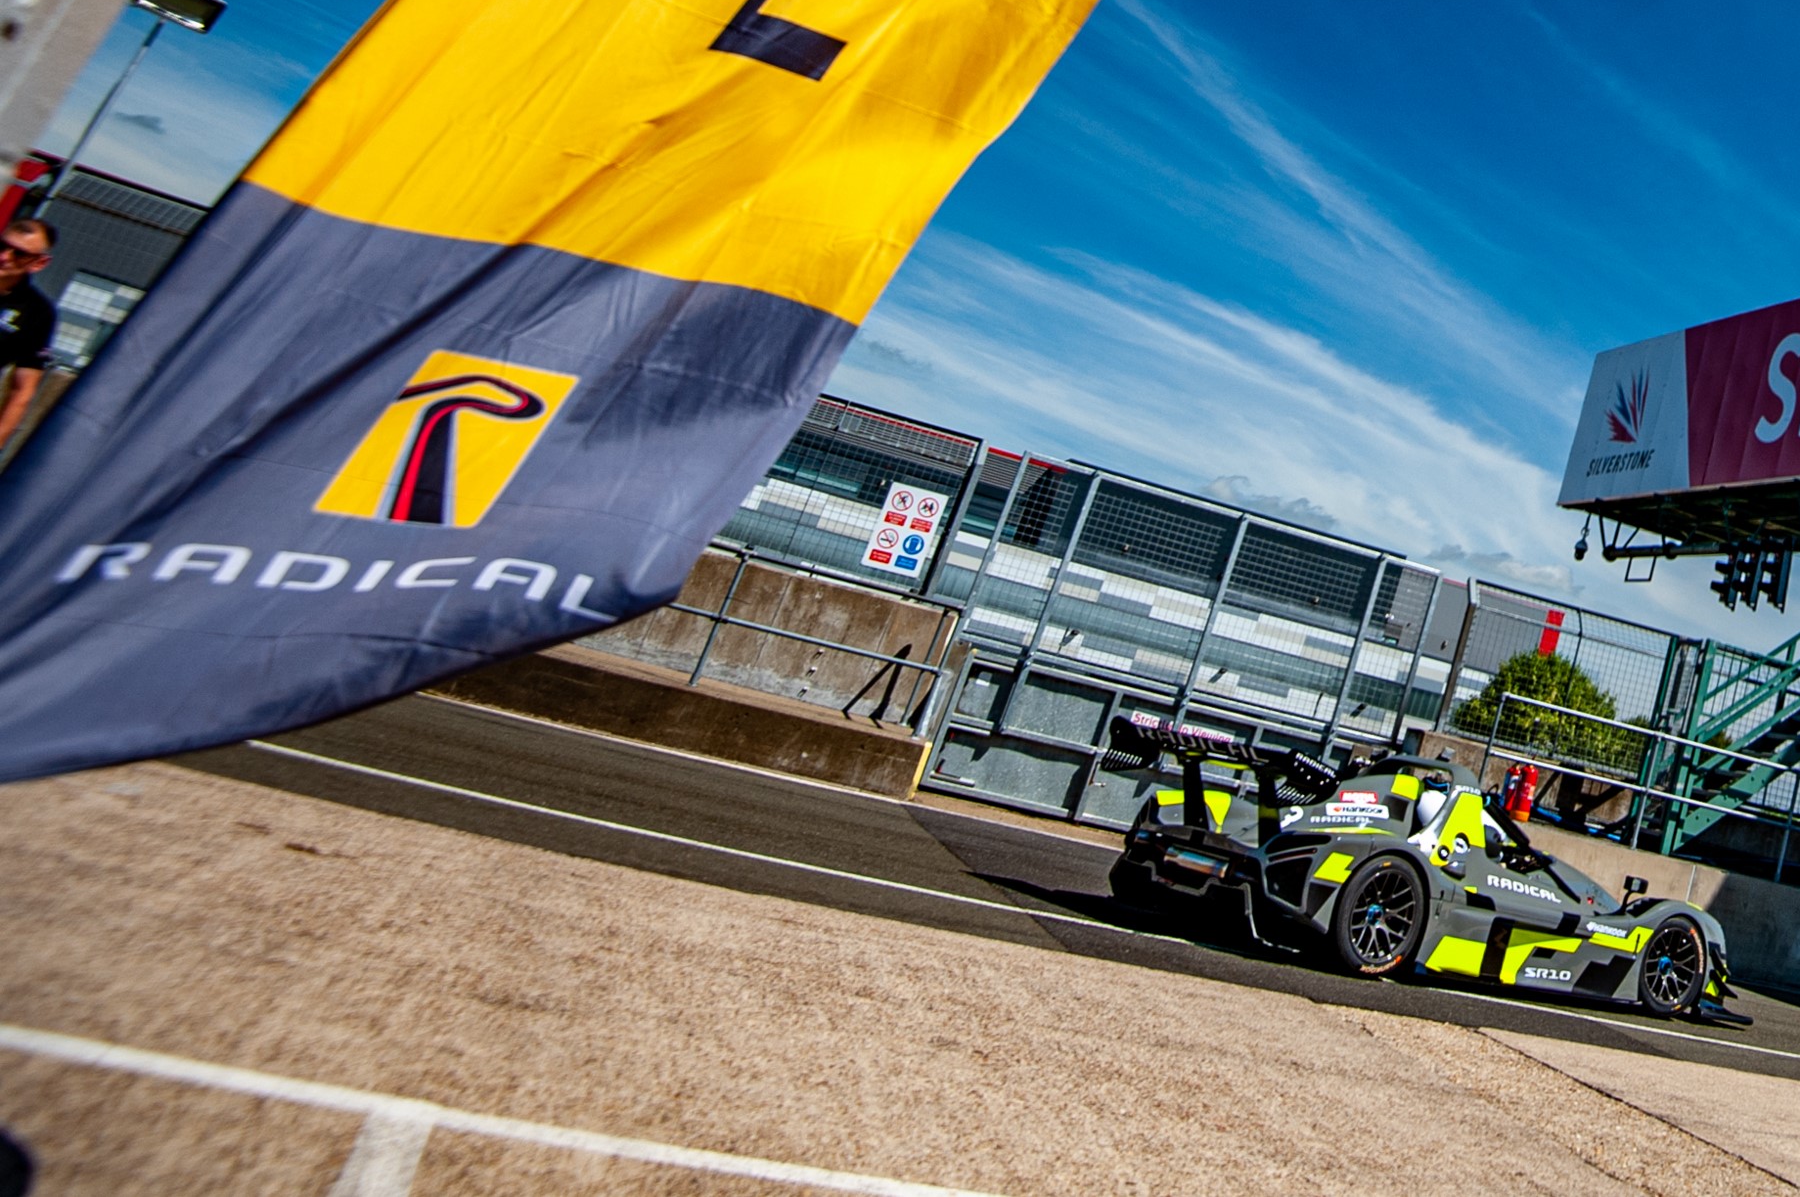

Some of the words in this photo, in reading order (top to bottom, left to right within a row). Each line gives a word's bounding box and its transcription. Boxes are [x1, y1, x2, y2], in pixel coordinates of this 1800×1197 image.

[1586, 448, 1655, 477] SILVERSTONE
[55, 542, 618, 623] RADICAL
[1136, 726, 1269, 763] RADICAL
[1295, 752, 1336, 778] RADICAL
[1310, 815, 1373, 824] RADICAL
[1487, 874, 1562, 903] RADICAL
[1524, 967, 1571, 981] SR10
